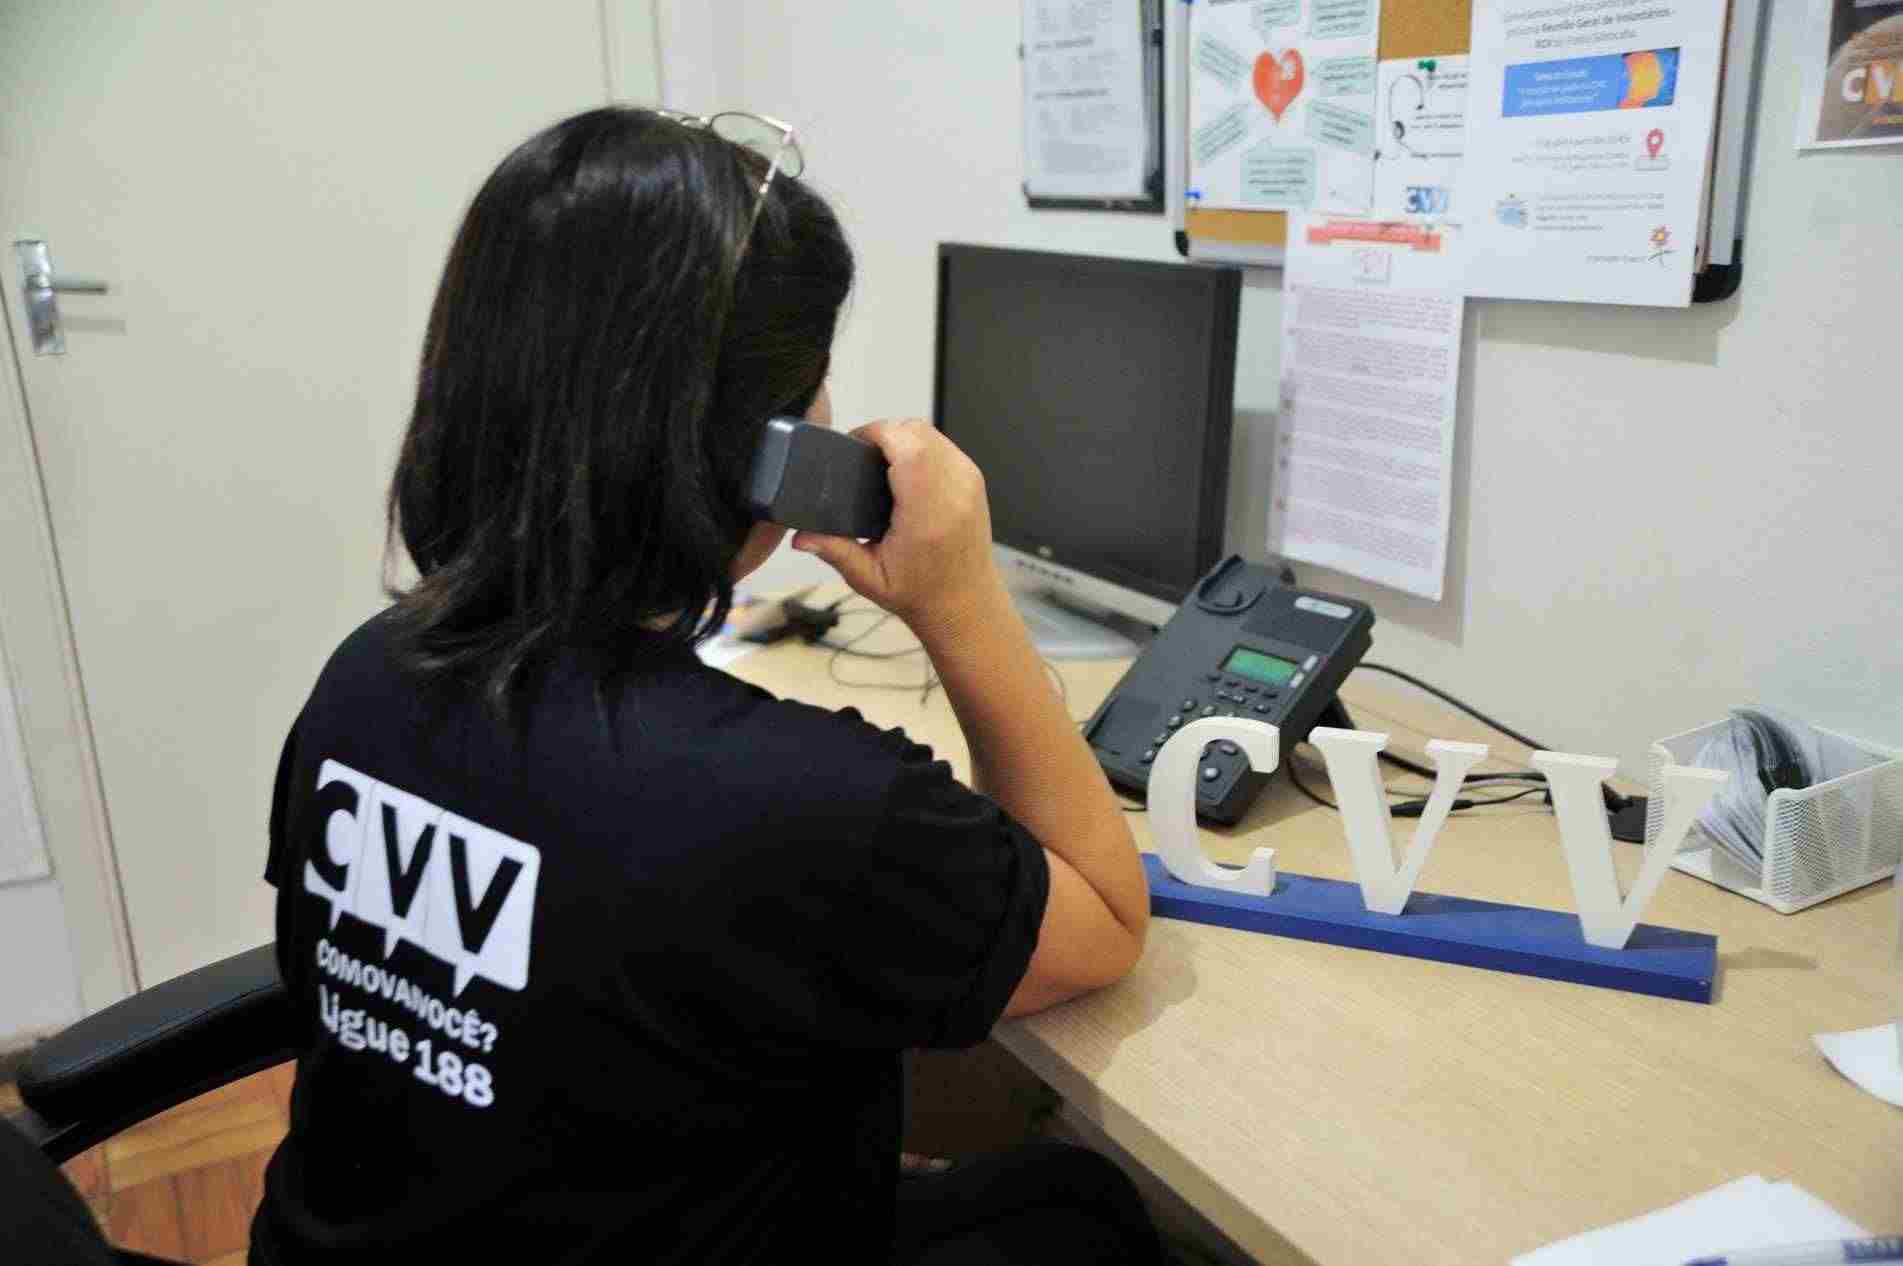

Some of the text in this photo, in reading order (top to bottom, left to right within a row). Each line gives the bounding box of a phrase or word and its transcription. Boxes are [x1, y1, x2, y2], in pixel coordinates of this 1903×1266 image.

[303, 779, 524, 956] CVV
[1146, 716, 1729, 950] CVV
[319, 984, 495, 1108] Ligue 188
